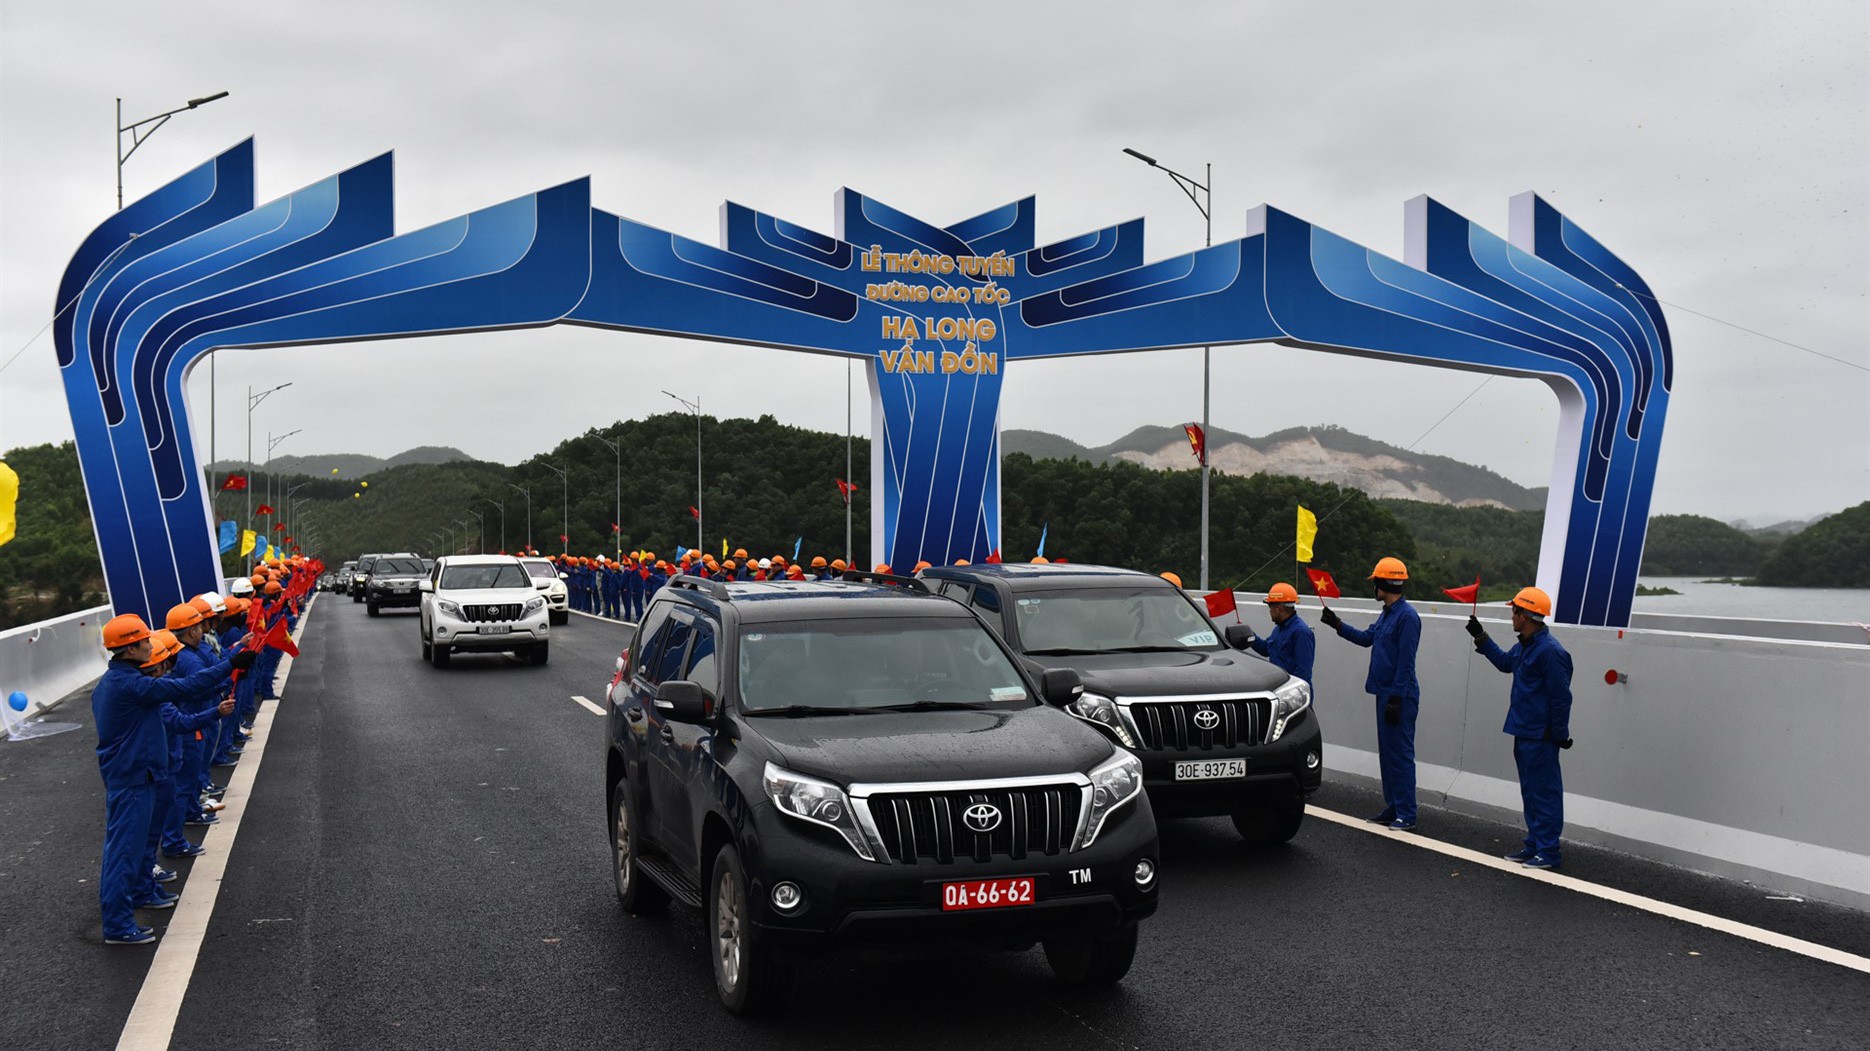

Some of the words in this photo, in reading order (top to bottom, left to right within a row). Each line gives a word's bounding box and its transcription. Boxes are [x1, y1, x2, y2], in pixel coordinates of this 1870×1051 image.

[861, 244, 881, 271] LỄ
[884, 249, 954, 274] THÔNG
[956, 249, 1015, 277] TUYẾN
[866, 280, 929, 302] ĐƯỜNG
[931, 286, 970, 303] CAO
[972, 281, 1010, 304] TỐC
[882, 316, 919, 345] HẠ
[926, 317, 996, 341] LONG
[941, 342, 997, 374] ĐỒN
[1191, 634, 1213, 644] VIP
[1069, 867, 1092, 885] TM
